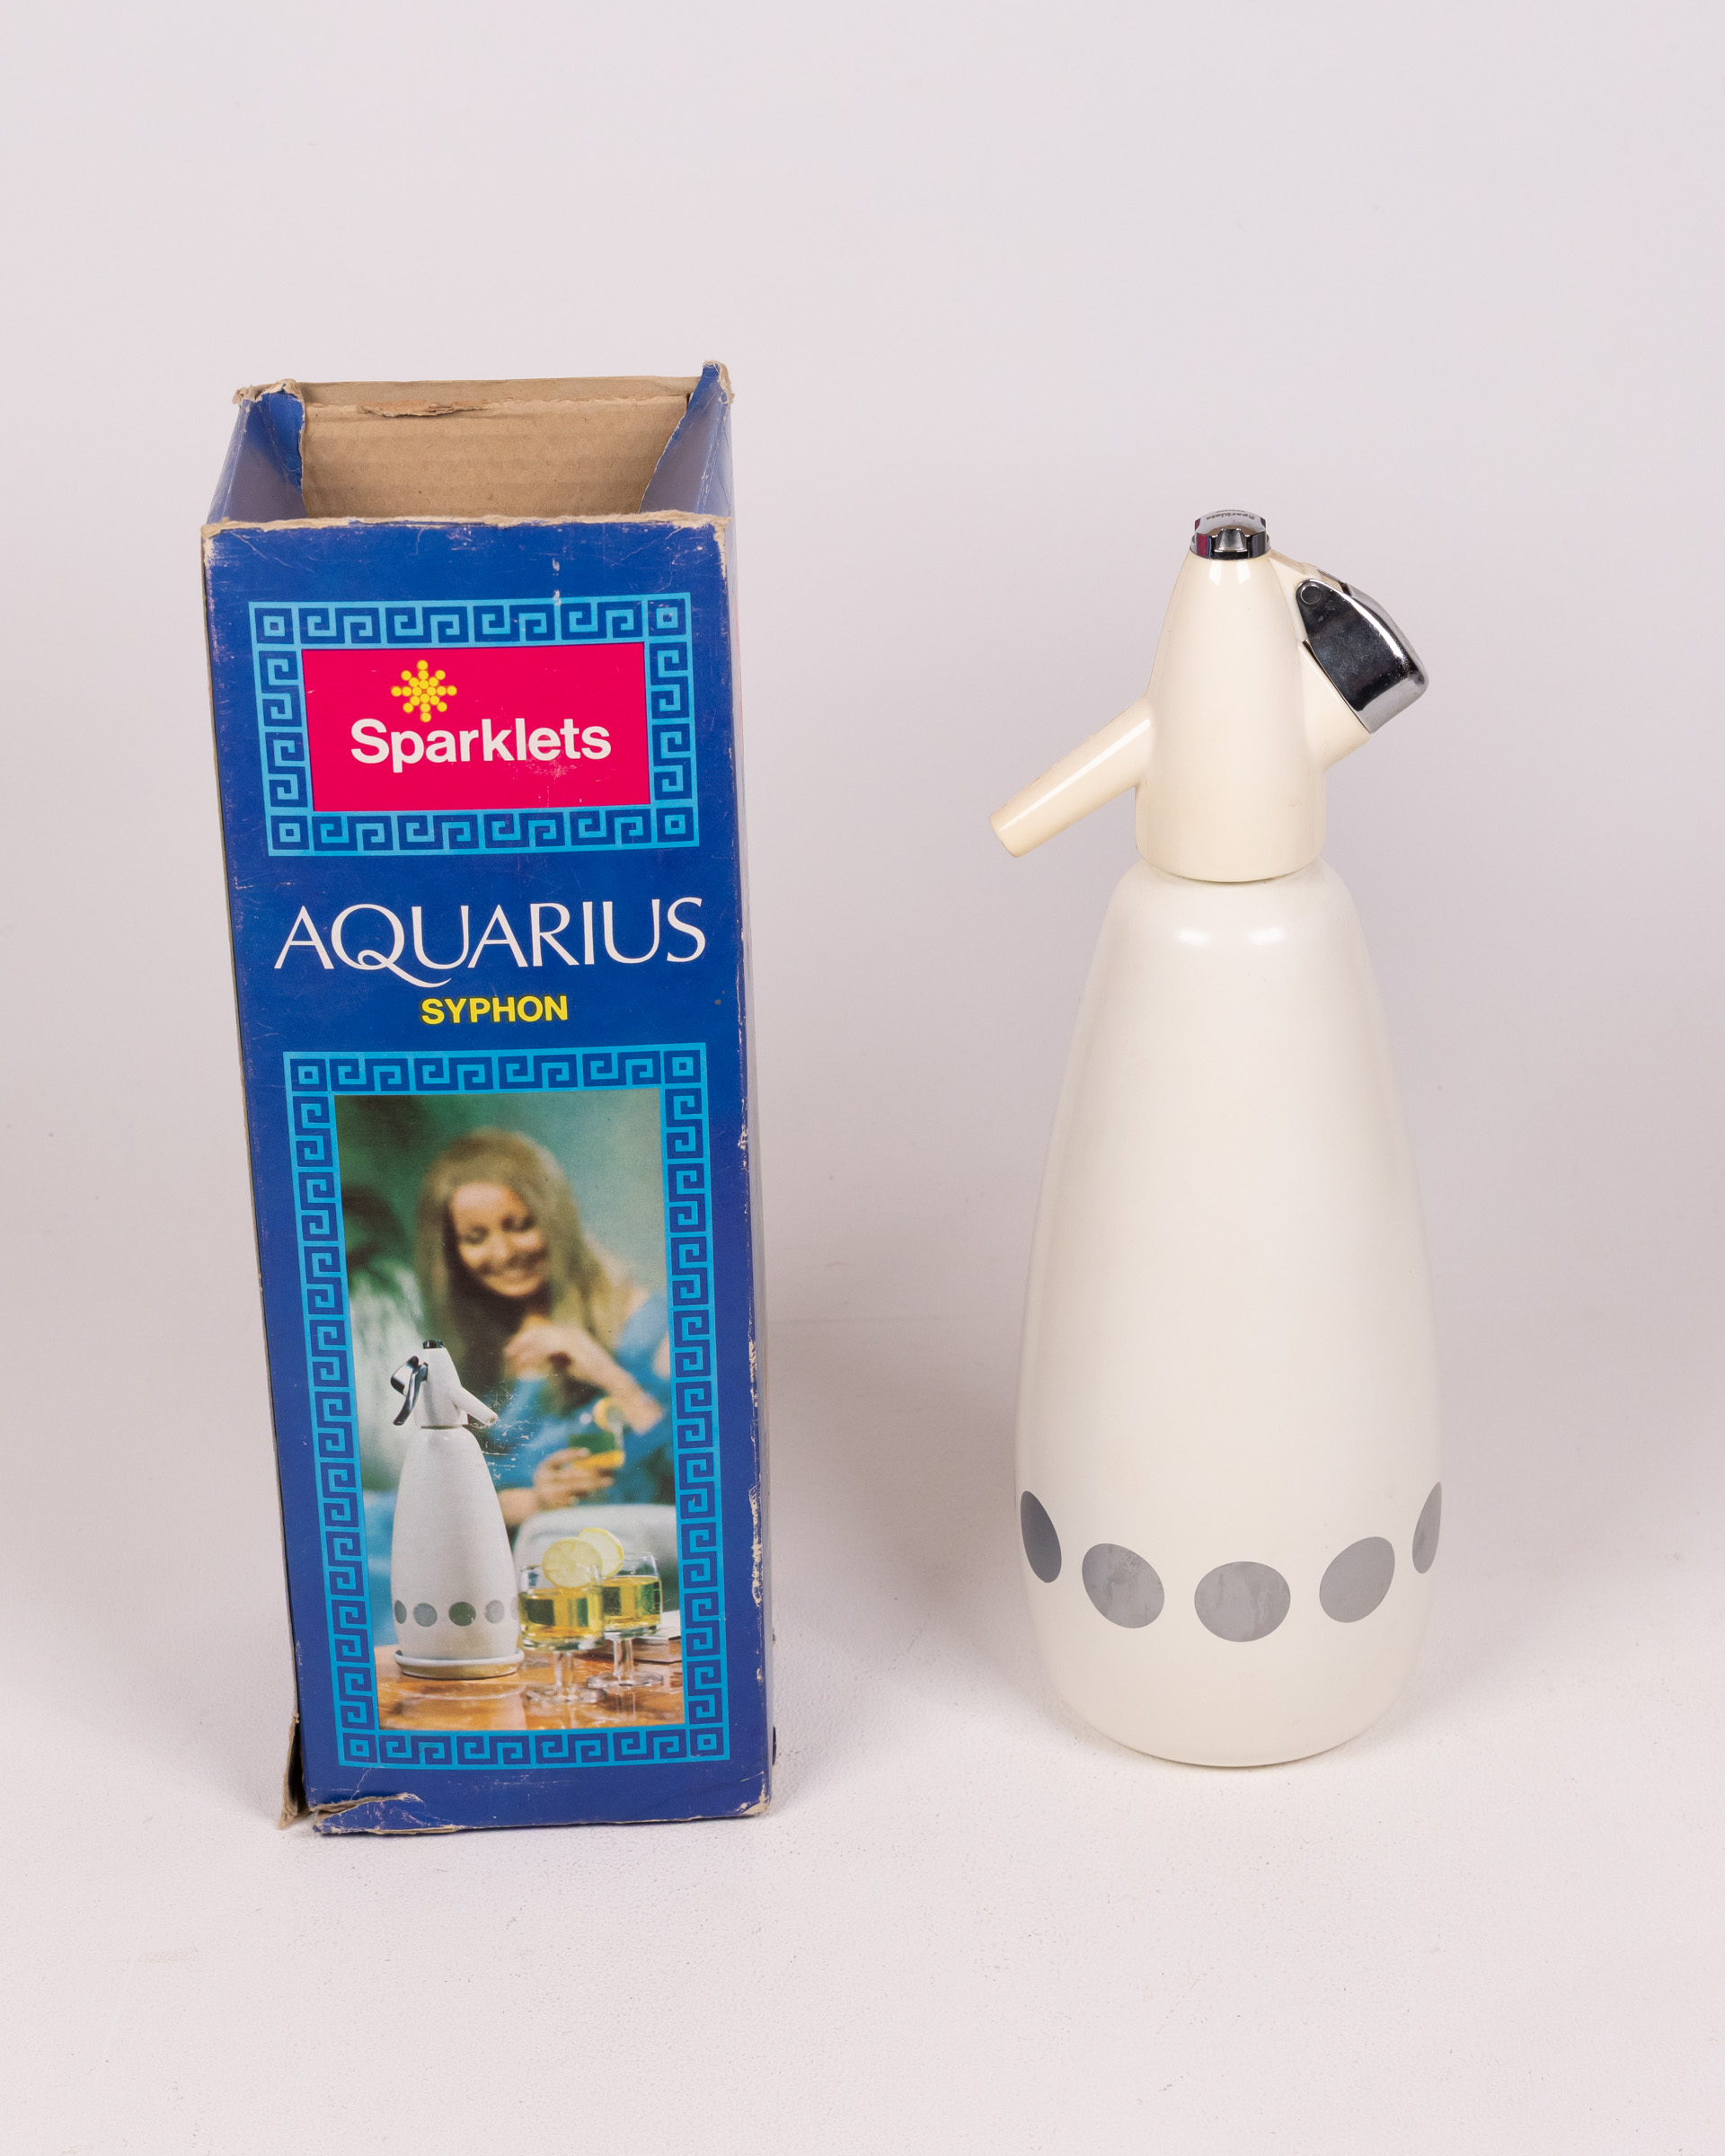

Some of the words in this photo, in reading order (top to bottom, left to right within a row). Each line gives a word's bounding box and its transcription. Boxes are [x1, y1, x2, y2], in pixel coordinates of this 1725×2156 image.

[350, 718, 612, 773] Sparklets
[274, 897, 706, 988] AQUARIUS
[421, 994, 569, 1026] SYPHON
